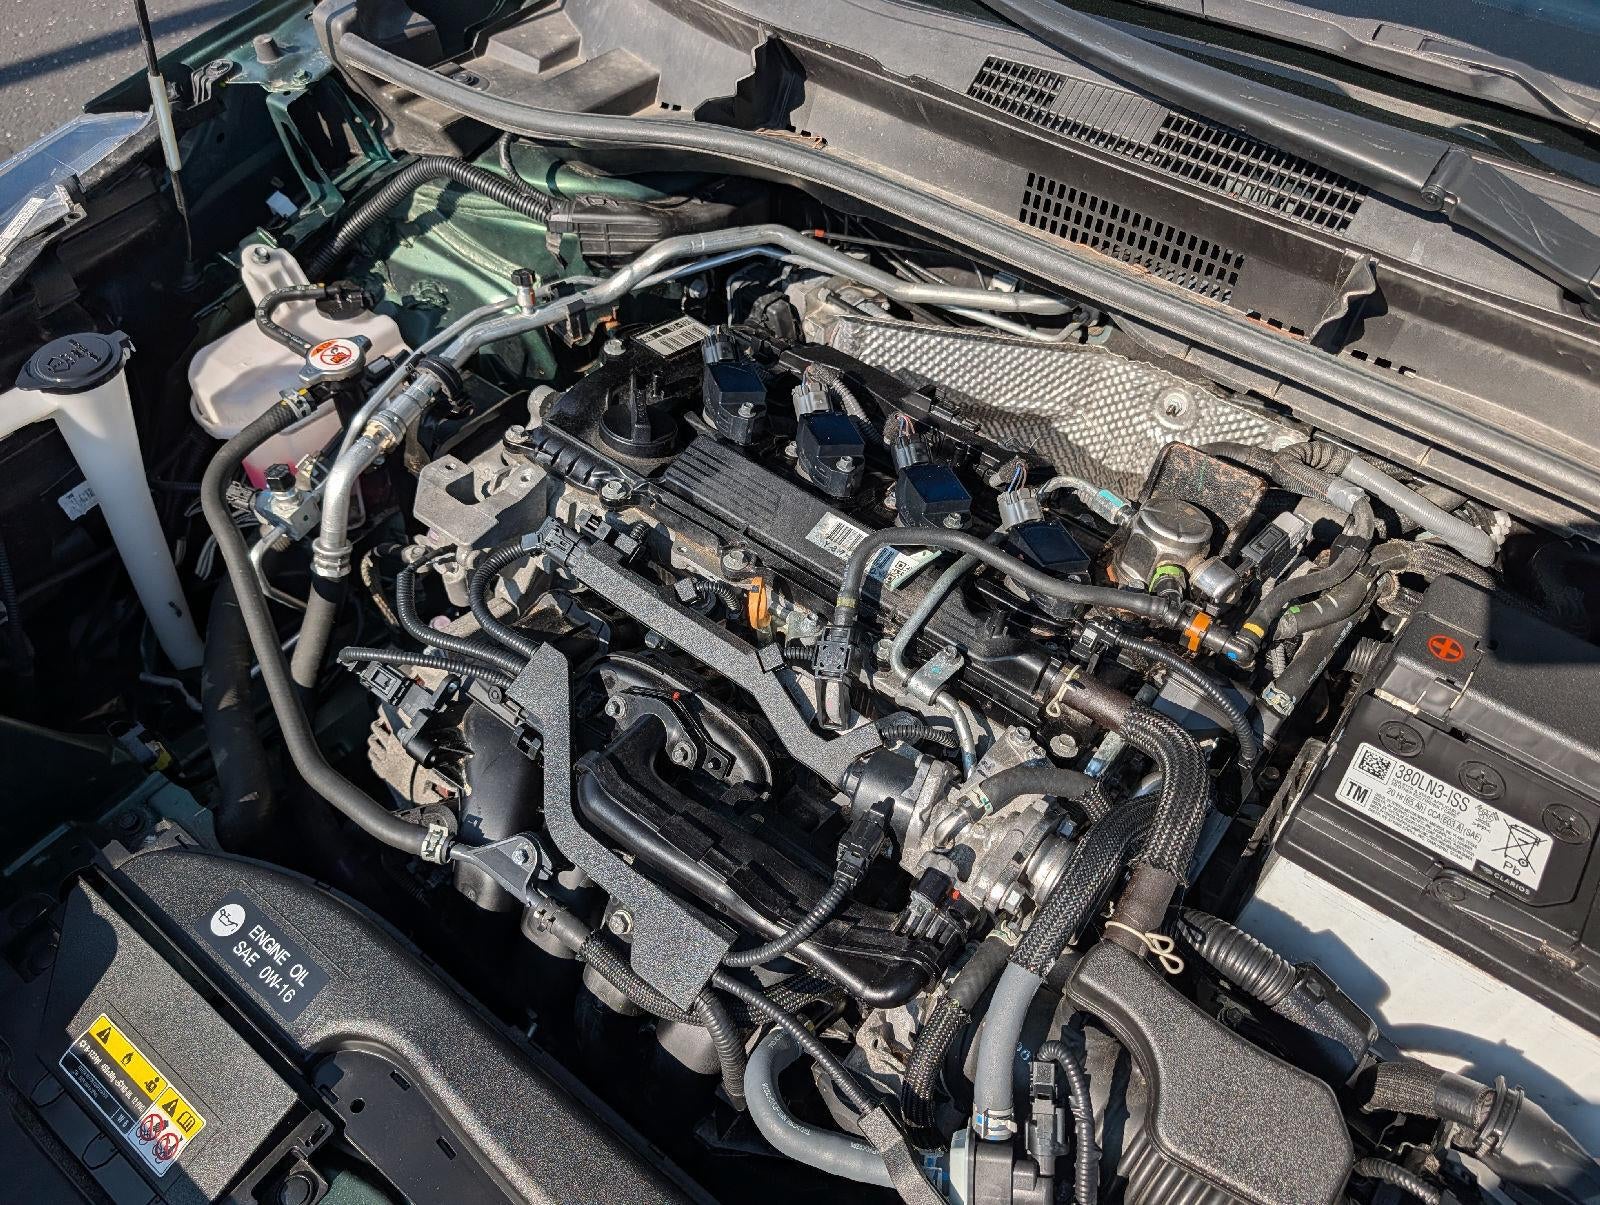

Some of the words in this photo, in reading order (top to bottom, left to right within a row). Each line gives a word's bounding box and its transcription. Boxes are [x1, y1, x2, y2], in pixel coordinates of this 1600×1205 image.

[1346, 781, 1369, 804] TM
[1395, 764, 1470, 812] 380LN3-ISS
[1387, 787, 1396, 797] 20
[1414, 801, 1424, 811] Ah
[1428, 808, 1440, 821] CCA
[1463, 828, 1482, 843] (SAE)
[1493, 872, 1530, 895] CLARIOS
[1503, 860, 1521, 876] Pb
[232, 941, 261, 968] SAE
[258, 965, 296, 1003] 0W-16
[248, 924, 291, 966] ENGINE
[289, 963, 309, 988] OIL
